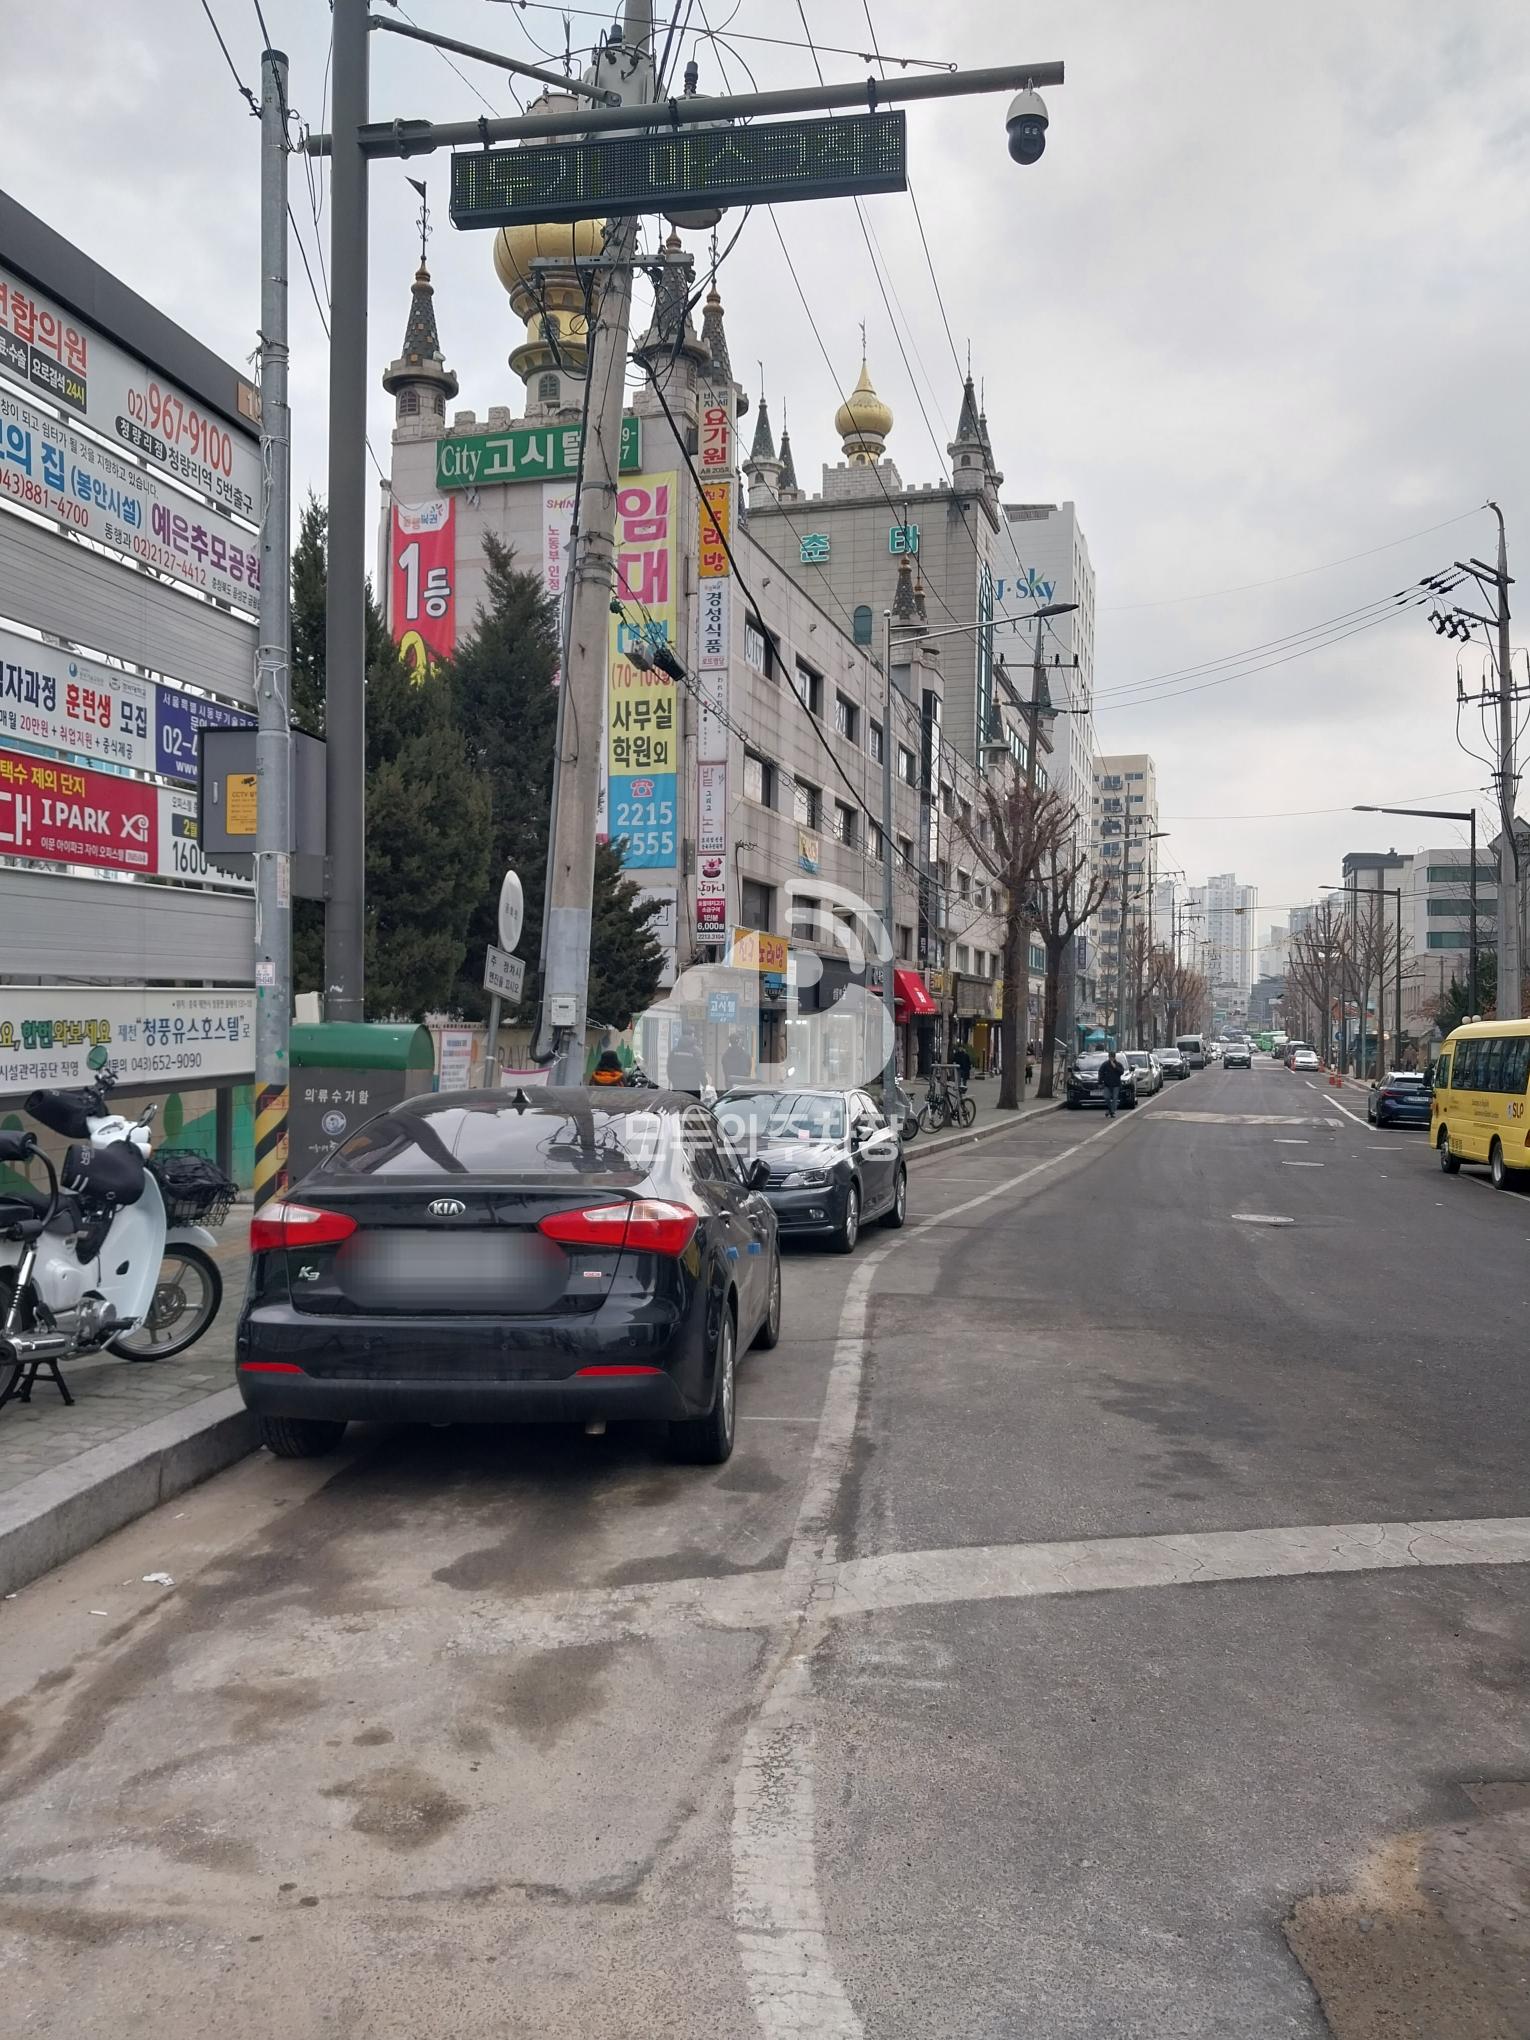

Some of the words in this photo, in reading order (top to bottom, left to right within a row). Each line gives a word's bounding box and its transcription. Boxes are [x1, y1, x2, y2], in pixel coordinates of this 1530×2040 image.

[32, 358, 65, 394] 요로결석
[66, 379, 85, 405] 24시
[22, 410, 40, 431] 되고
[42, 422, 67, 449] 쉼터가
[703, 408, 729, 465] 요가원
[119, 419, 163, 459] 청량리점
[168, 447, 212, 492] 청량리역
[216, 478, 253, 514] 5번출구
[440, 443, 481, 482] City
[0, 468, 89, 528] 43)881-4700
[41, 442, 65, 493] 집
[71, 465, 142, 529] (봉안시설)
[105, 522, 131, 550] 동행과
[800, 532, 830, 564] 춘
[888, 523, 919, 554] 태
[705, 592, 723, 654] 경성식품
[0, 660, 56, 712] 자과정
[66, 683, 111, 729] 훈련생
[120, 700, 147, 739] 모집
[612, 697, 673, 733] 사무실
[20, 714, 49, 738] 20만원
[60, 725, 93, 749] 취업지원
[103, 737, 134, 761] 중식제공
[612, 734, 668, 768] 학원외
[31, 766, 57, 792] 제외
[61, 774, 86, 798] 단지
[616, 801, 673, 827] 2215
[57, 839, 84, 854] 아이파크
[60, 1061, 79, 1078] 직영
[304, 1087, 369, 1105] 의류수거함
[298, 1266, 321, 1281] K3
